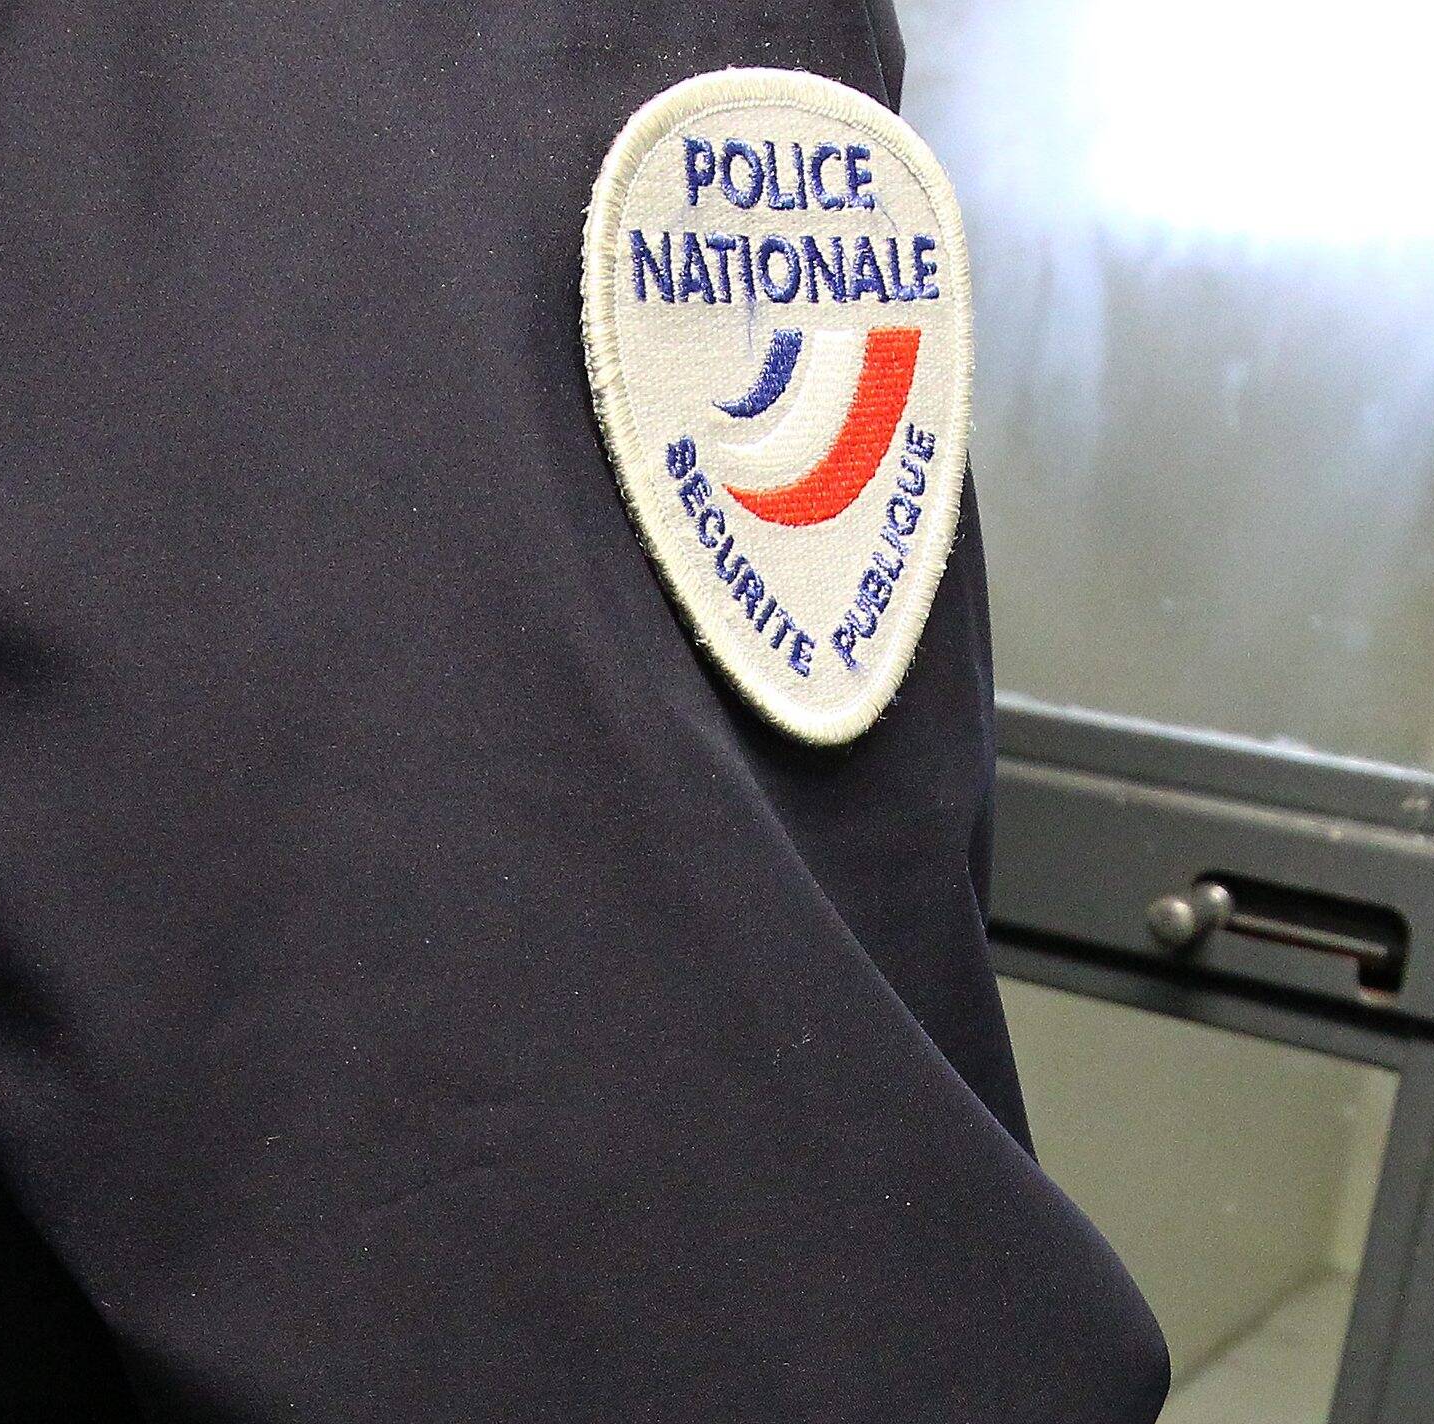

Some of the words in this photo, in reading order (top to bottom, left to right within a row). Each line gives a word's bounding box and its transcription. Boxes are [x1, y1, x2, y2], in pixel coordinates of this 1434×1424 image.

[683, 136, 876, 211] POLICE
[631, 229, 940, 303] NATIONALE
[664, 435, 817, 677] SECURITE
[830, 423, 936, 671] PUBLIQUE
